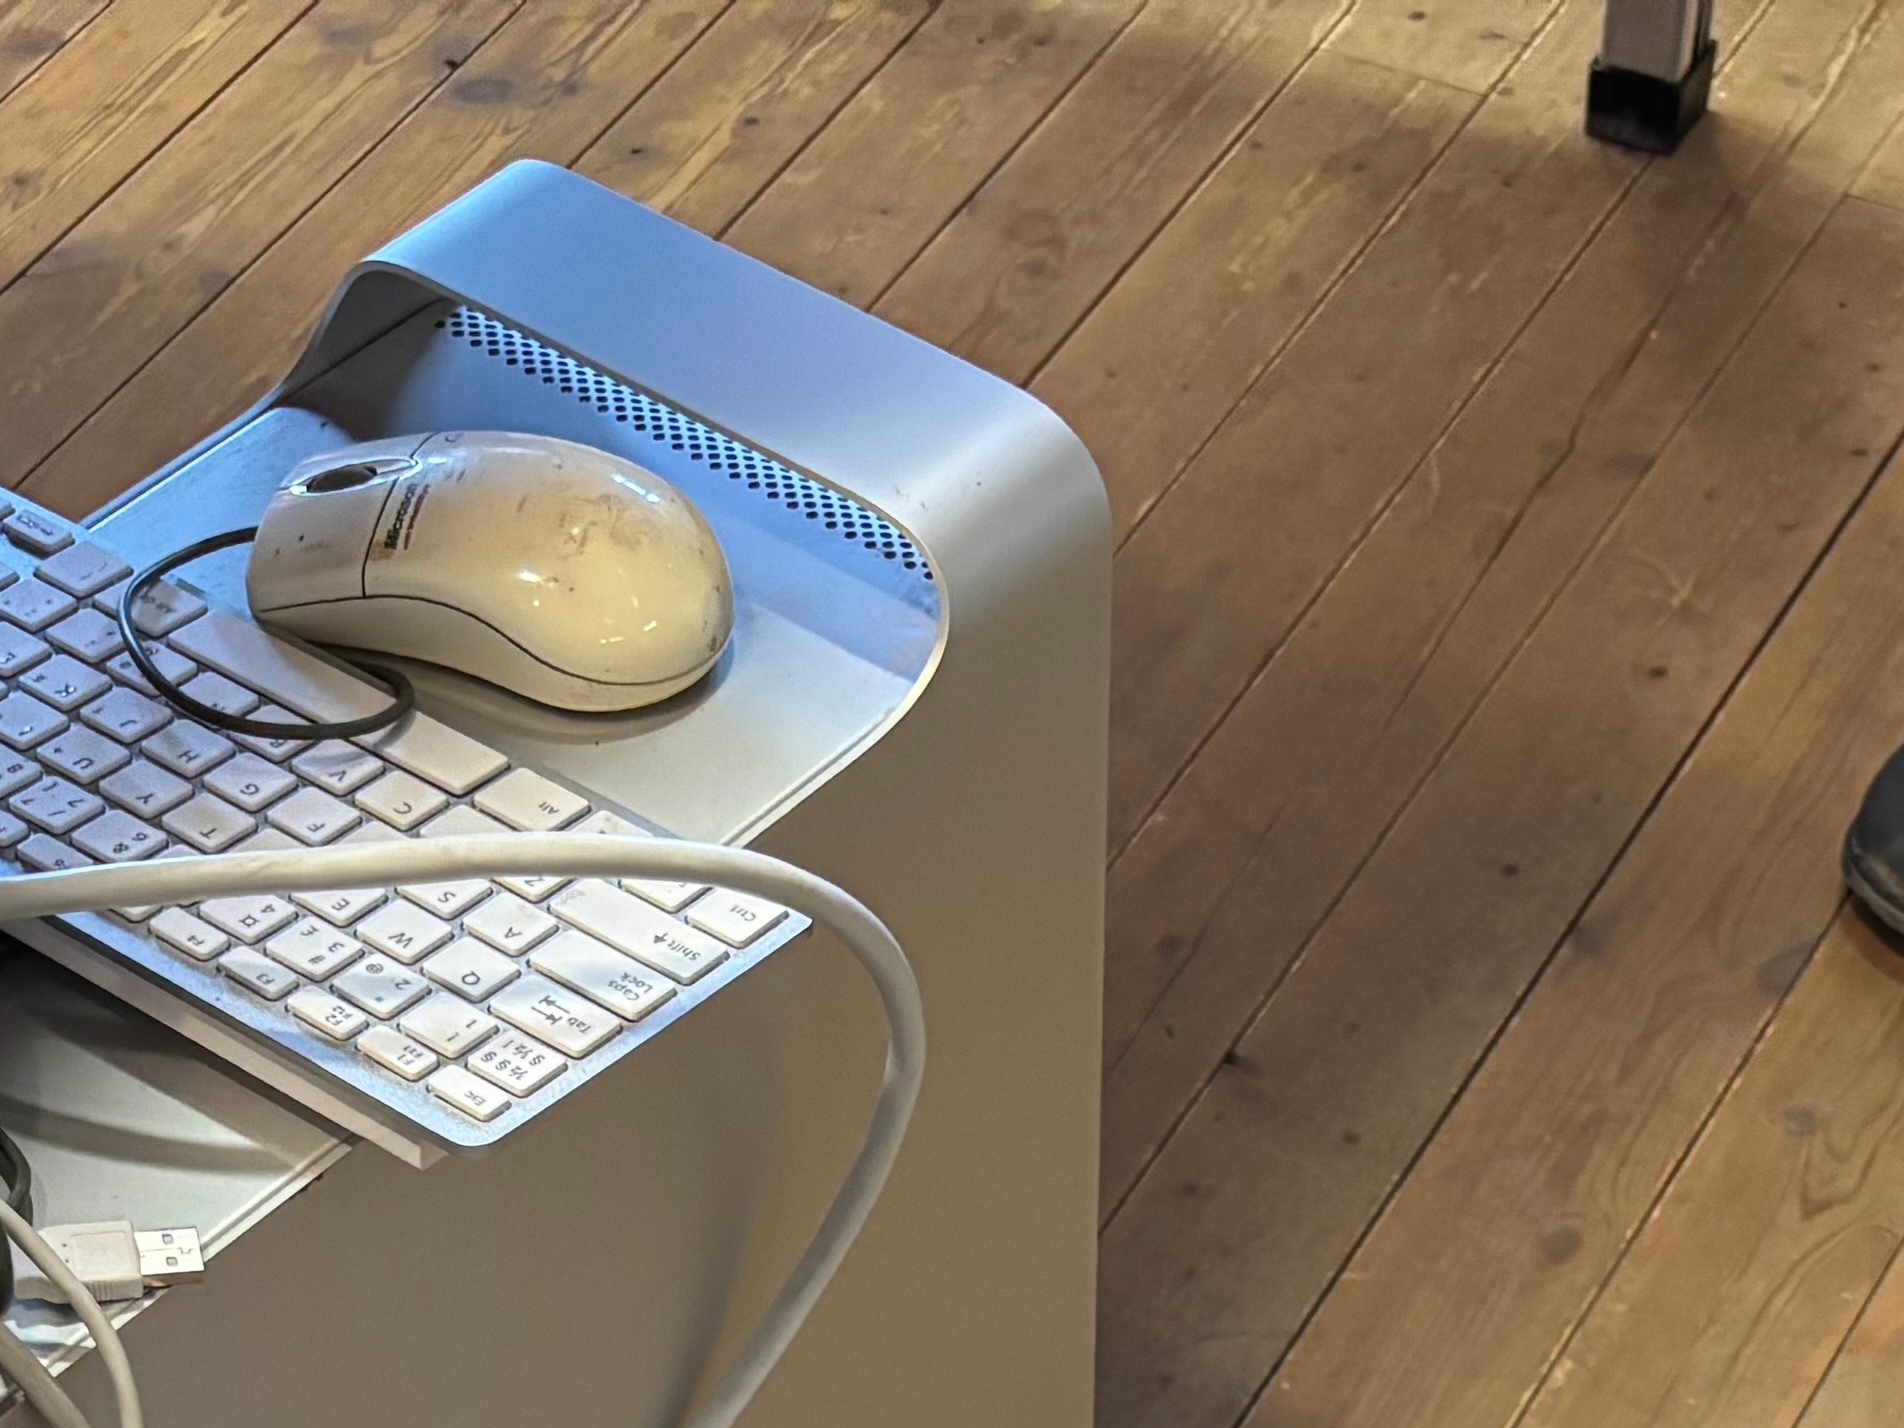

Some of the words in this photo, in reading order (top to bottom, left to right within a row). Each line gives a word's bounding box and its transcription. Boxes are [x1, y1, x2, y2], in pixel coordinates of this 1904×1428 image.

[71, 756, 95, 770] U
[176, 748, 199, 764] H
[327, 768, 347, 782] V
[238, 782, 260, 796] G
[134, 792, 154, 805] Y
[392, 800, 413, 815] C
[537, 800, 560, 815] Alt
[198, 826, 218, 839] T
[305, 822, 326, 833] F
[436, 890, 456, 903] S
[330, 897, 351, 911] E
[729, 904, 757, 922] Ctrl
[503, 925, 523, 939] A
[326, 940, 345, 953] 3
[387, 931, 413, 949] W
[666, 938, 701, 961] Shift
[364, 962, 384, 974] @
[460, 969, 481, 986] Q
[619, 970, 653, 994] Lock
[606, 978, 640, 1001] Caps
[566, 1016, 592, 1034] Tab
